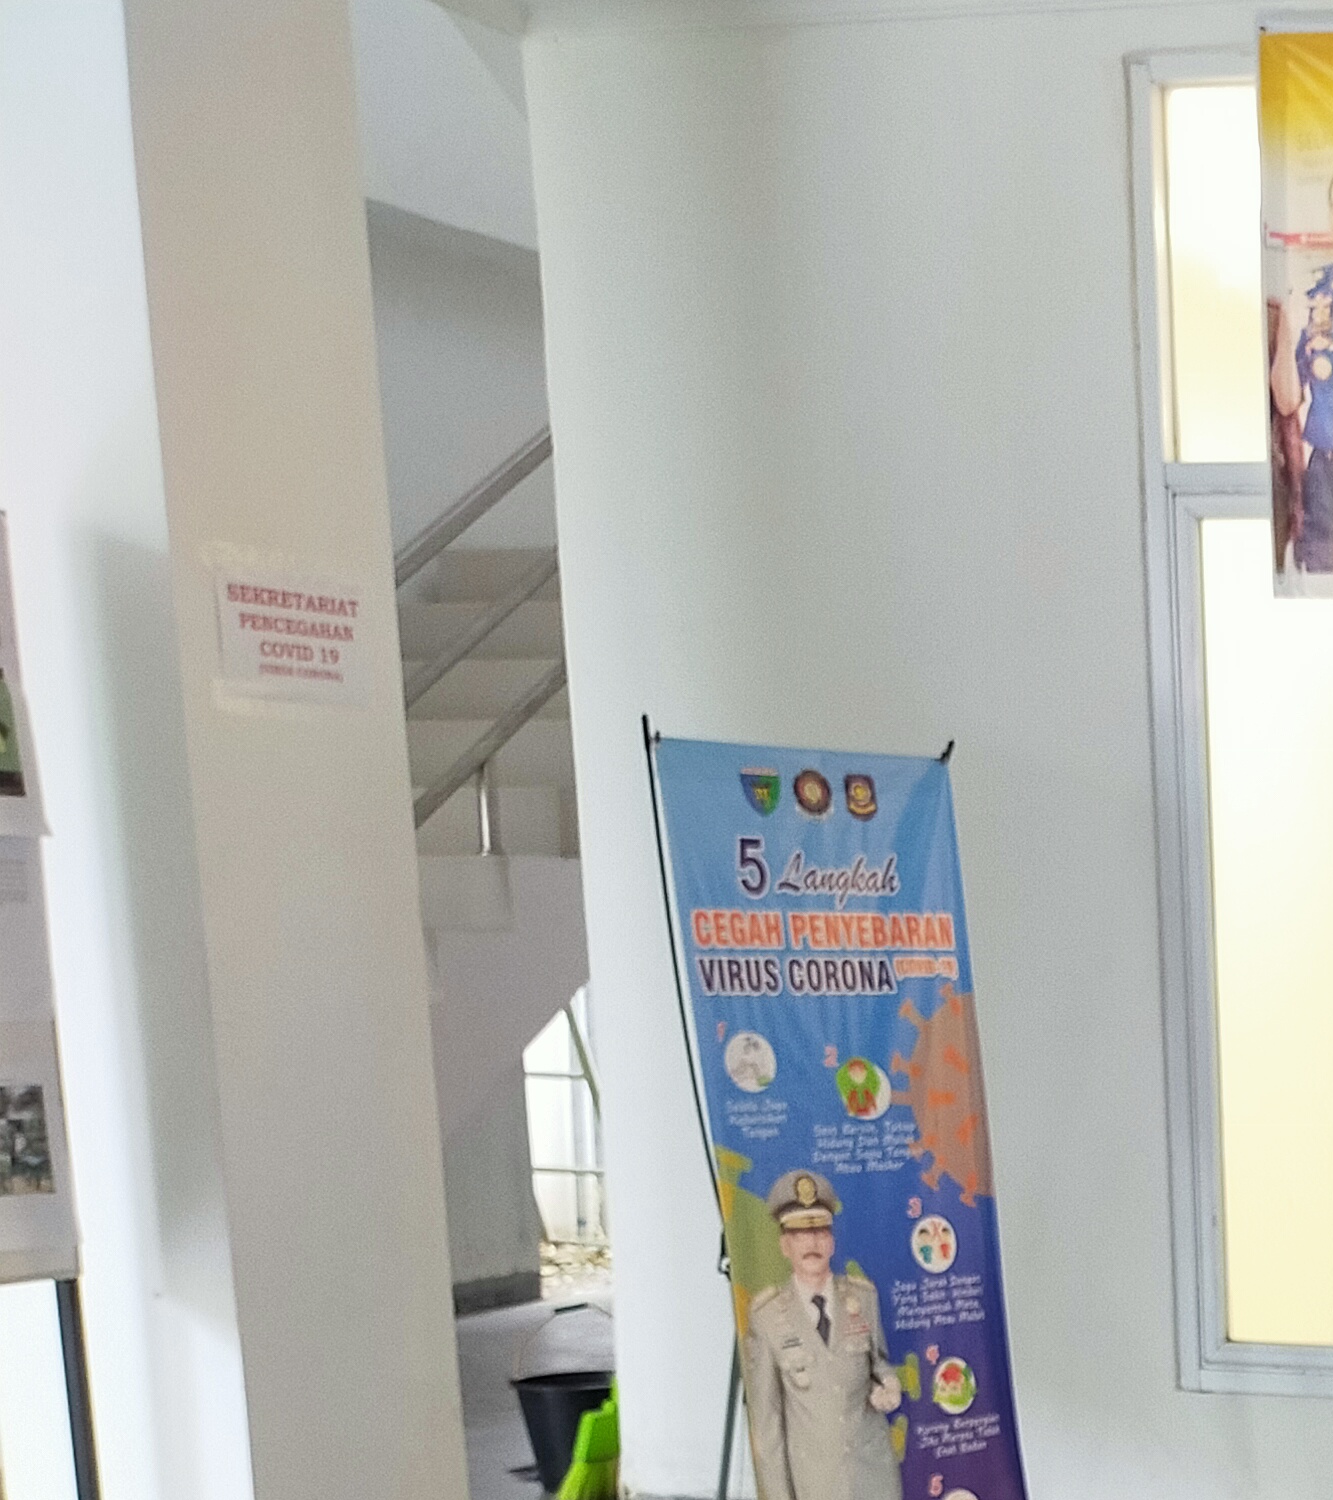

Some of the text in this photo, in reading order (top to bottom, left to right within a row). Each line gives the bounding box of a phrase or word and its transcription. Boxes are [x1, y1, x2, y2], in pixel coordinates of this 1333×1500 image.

[227, 582, 358, 618] SEKRETARIAT
[239, 611, 354, 642] PENCEGAHAN
[259, 640, 340, 665] COVID 19
[738, 837, 900, 909] 5 Langkah
[692, 908, 955, 950] CEGAH PENYEBARAN
[697, 956, 782, 995] VIRUS
[788, 957, 896, 995] CORONA
